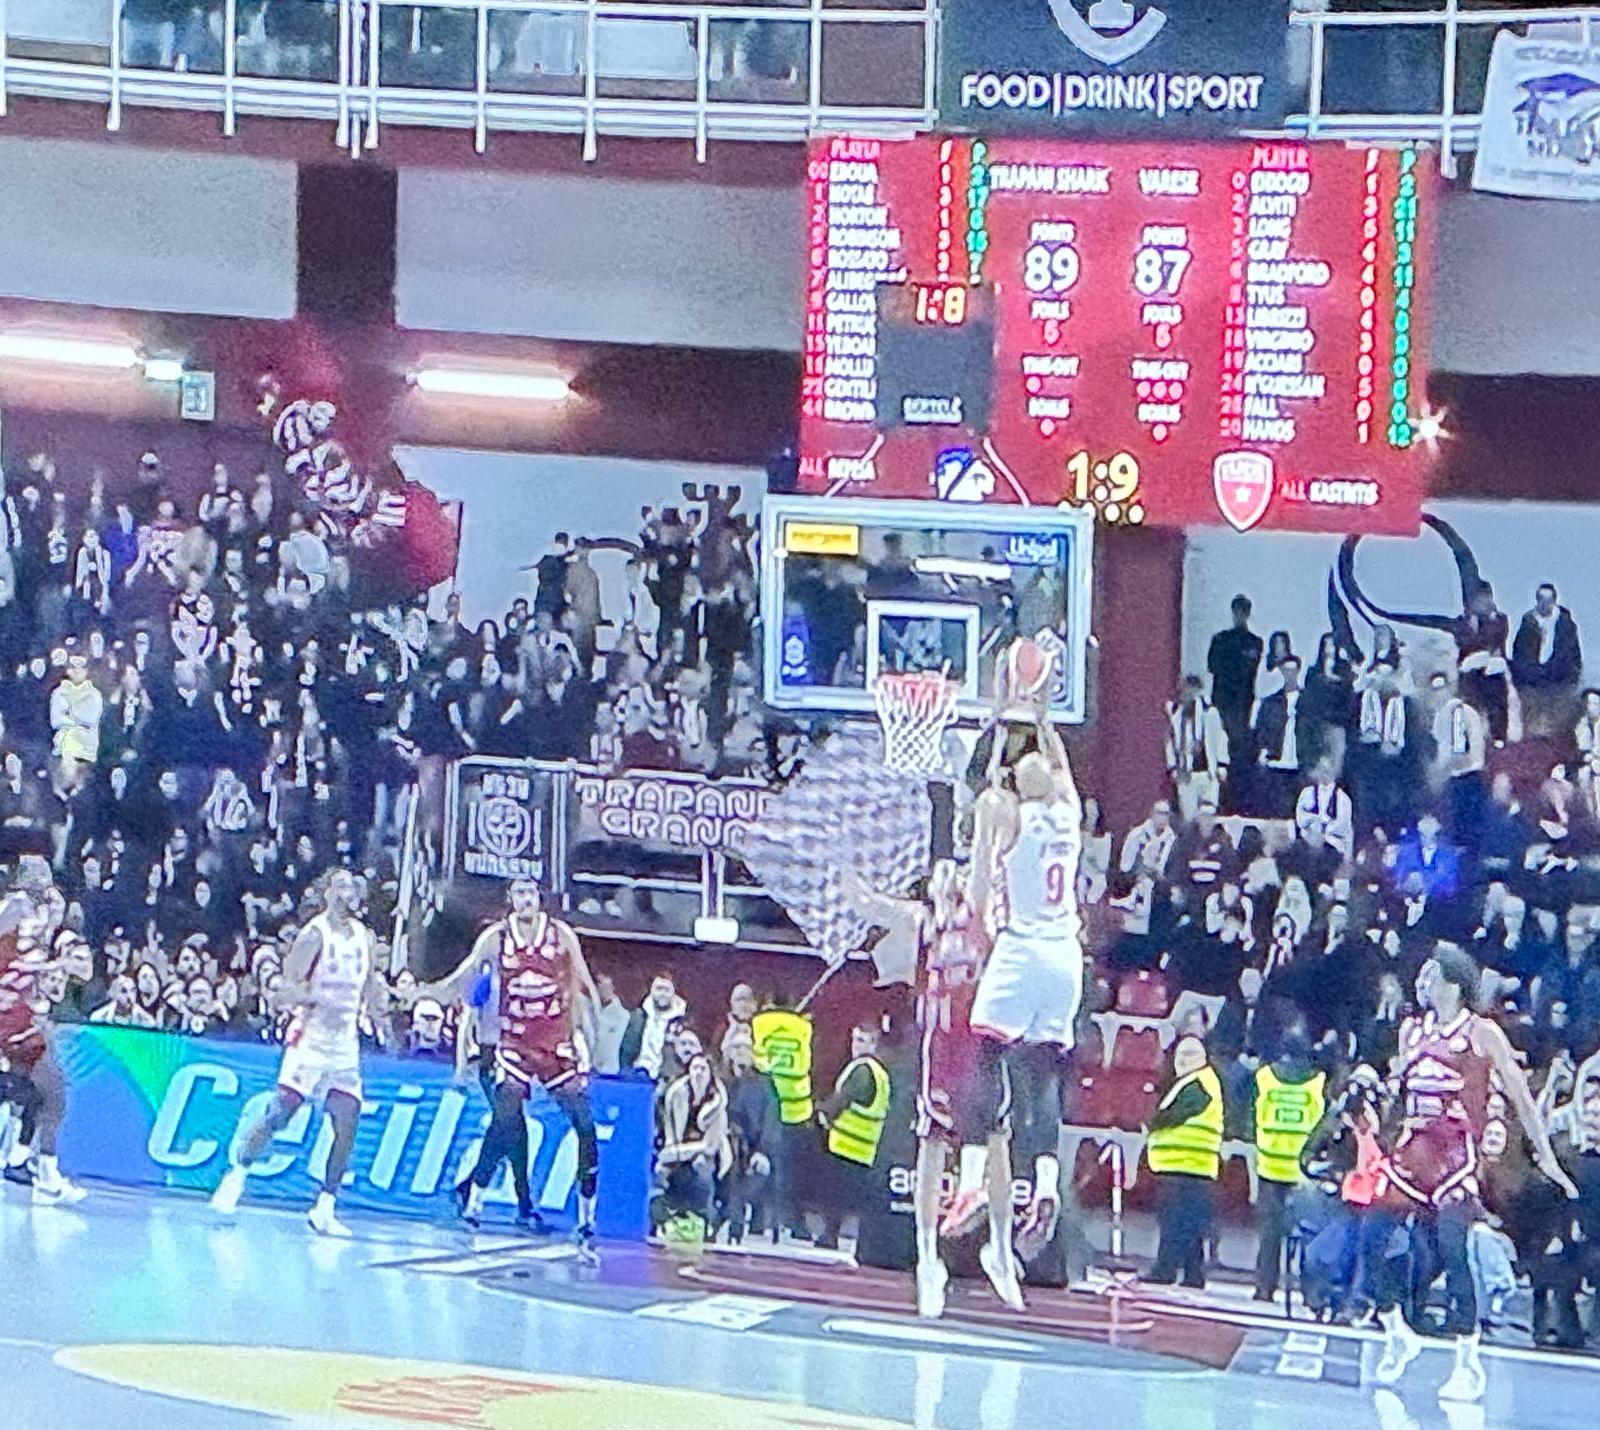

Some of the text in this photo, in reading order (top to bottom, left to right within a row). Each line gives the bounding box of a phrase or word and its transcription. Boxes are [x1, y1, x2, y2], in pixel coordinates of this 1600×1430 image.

[1024, 244, 1080, 293] 89
[1134, 247, 1193, 297] 87
[1046, 863, 1065, 906] 9
